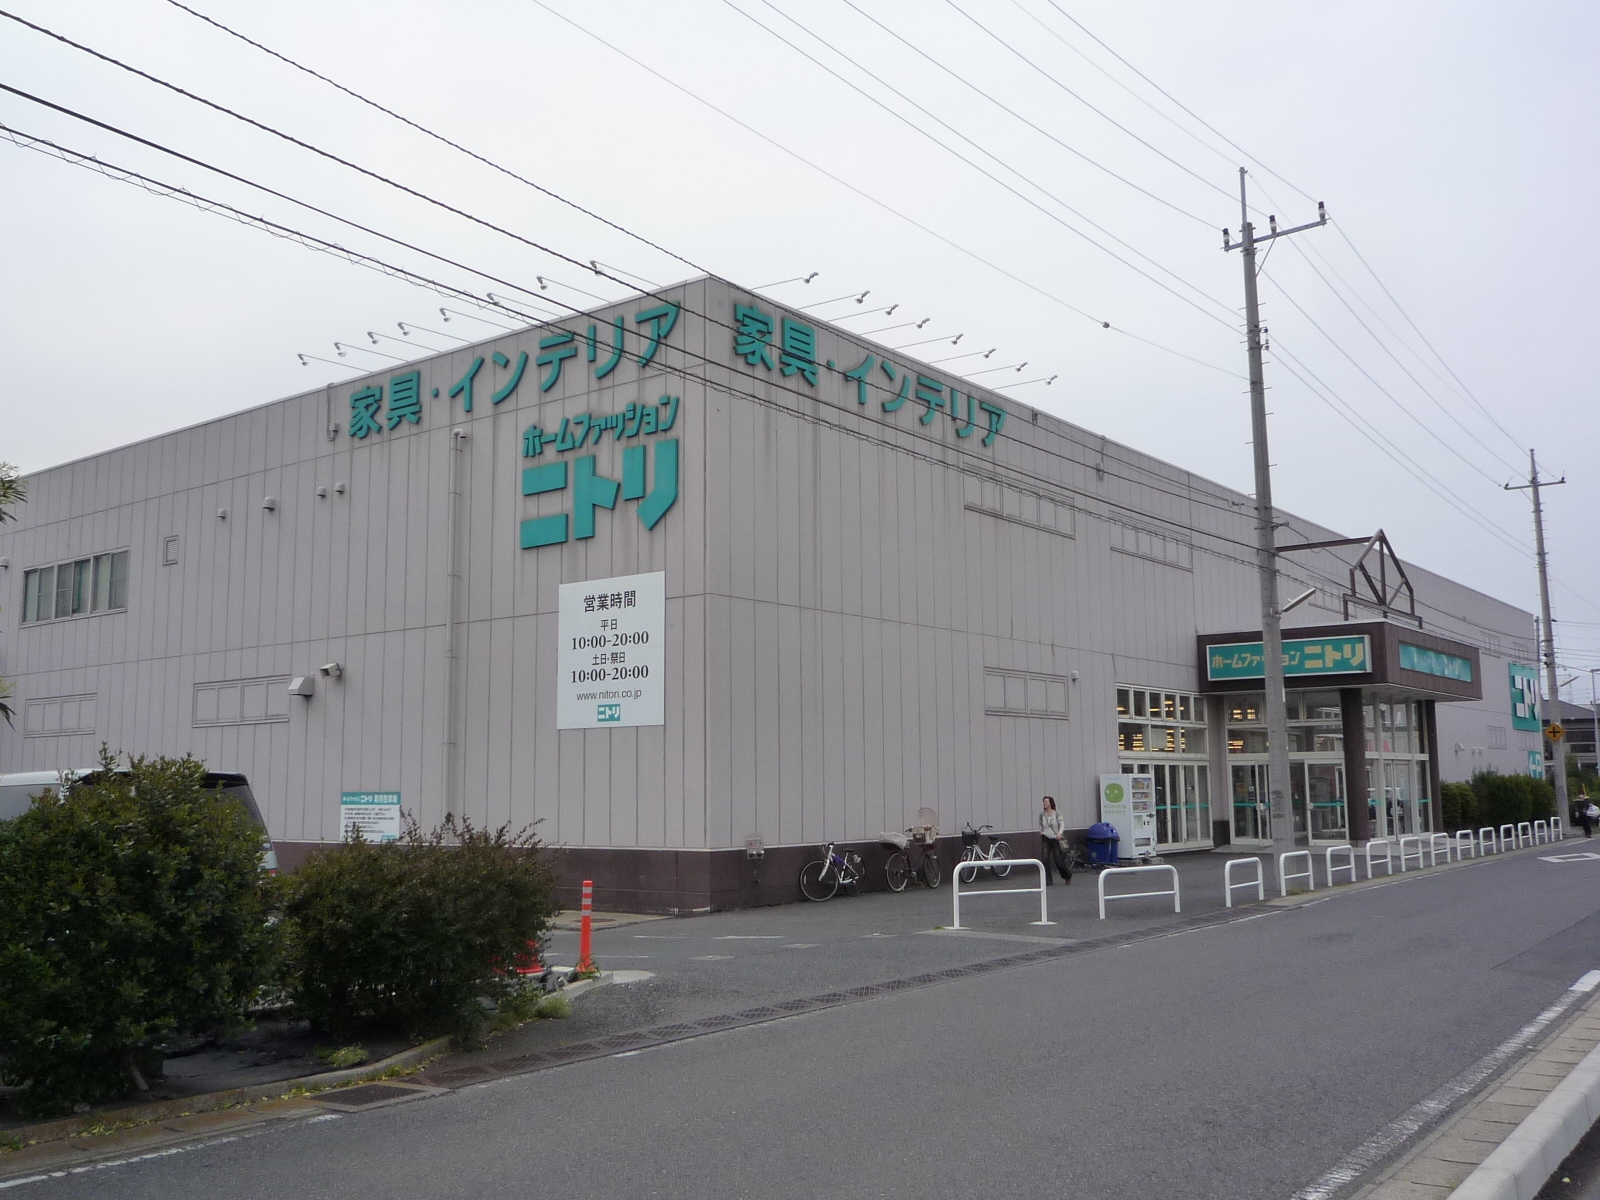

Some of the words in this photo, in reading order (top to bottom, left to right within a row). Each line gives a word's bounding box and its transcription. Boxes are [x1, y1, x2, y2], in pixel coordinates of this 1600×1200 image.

[348, 301, 681, 439] 家具・インテリア
[733, 302, 1006, 448] 家具・インテリア
[522, 395, 680, 458] ホームファッション
[520, 438, 679, 549] ニトリ
[583, 590, 637, 613] 営業時間
[600, 618, 618, 631] 平日
[571, 630, 649, 650] 10:00-20:00
[1211, 651, 1301, 669] ホームファョン
[1304, 643, 1364, 669] ニトリ
[571, 664, 649, 684] 10:00-20:00
[576, 688, 642, 701] www.nitori.co.jp
[597, 705, 620, 720] ニトリ
